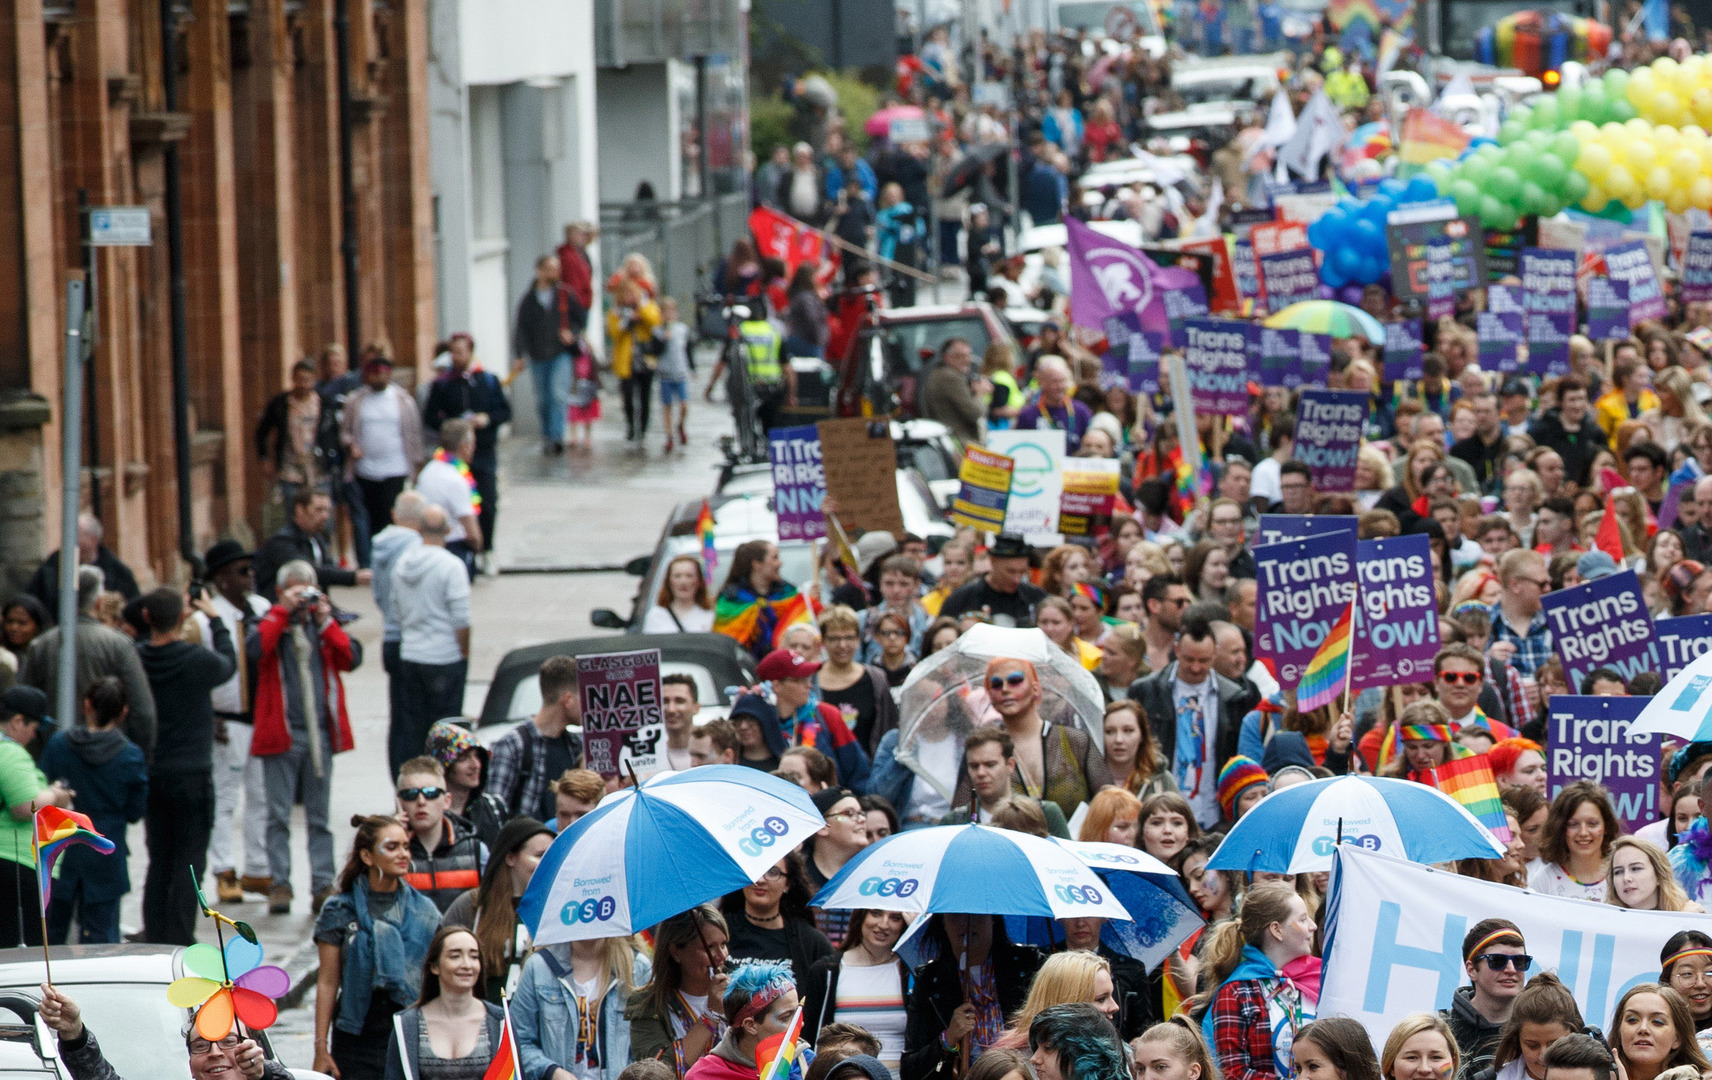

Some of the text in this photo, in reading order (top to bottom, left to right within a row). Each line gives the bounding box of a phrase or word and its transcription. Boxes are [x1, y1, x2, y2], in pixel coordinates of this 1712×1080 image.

[1185, 327, 1245, 350] Trans
[1186, 349, 1247, 372] Rights
[1302, 400, 1362, 421] Trans
[1298, 421, 1360, 447] Rights
[1294, 443, 1358, 468] Now!
[1258, 552, 1351, 588] Trans
[1356, 555, 1426, 584] rans
[1266, 580, 1354, 620] Rights
[1361, 582, 1432, 621] ights
[1548, 590, 1639, 634] Trans
[1367, 610, 1438, 650] ow!
[1559, 617, 1650, 663] Rights
[578, 652, 659, 672] GLASGOW
[585, 679, 656, 712] NAE
[583, 705, 661, 734] NAZIS
[589, 738, 612, 753] NO
[632, 758, 657, 768] unite
[1552, 746, 1655, 786] Rights
[1323, 816, 1371, 827] Borowed
[738, 816, 789, 857] TSB
[882, 860, 924, 870] Borrowed
[888, 868, 908, 877] from
[573, 874, 612, 888] Borrowed
[582, 887, 601, 897] from
[858, 876, 919, 898] TSB
[1054, 884, 1103, 905] TSB
[560, 895, 616, 926] TSB
